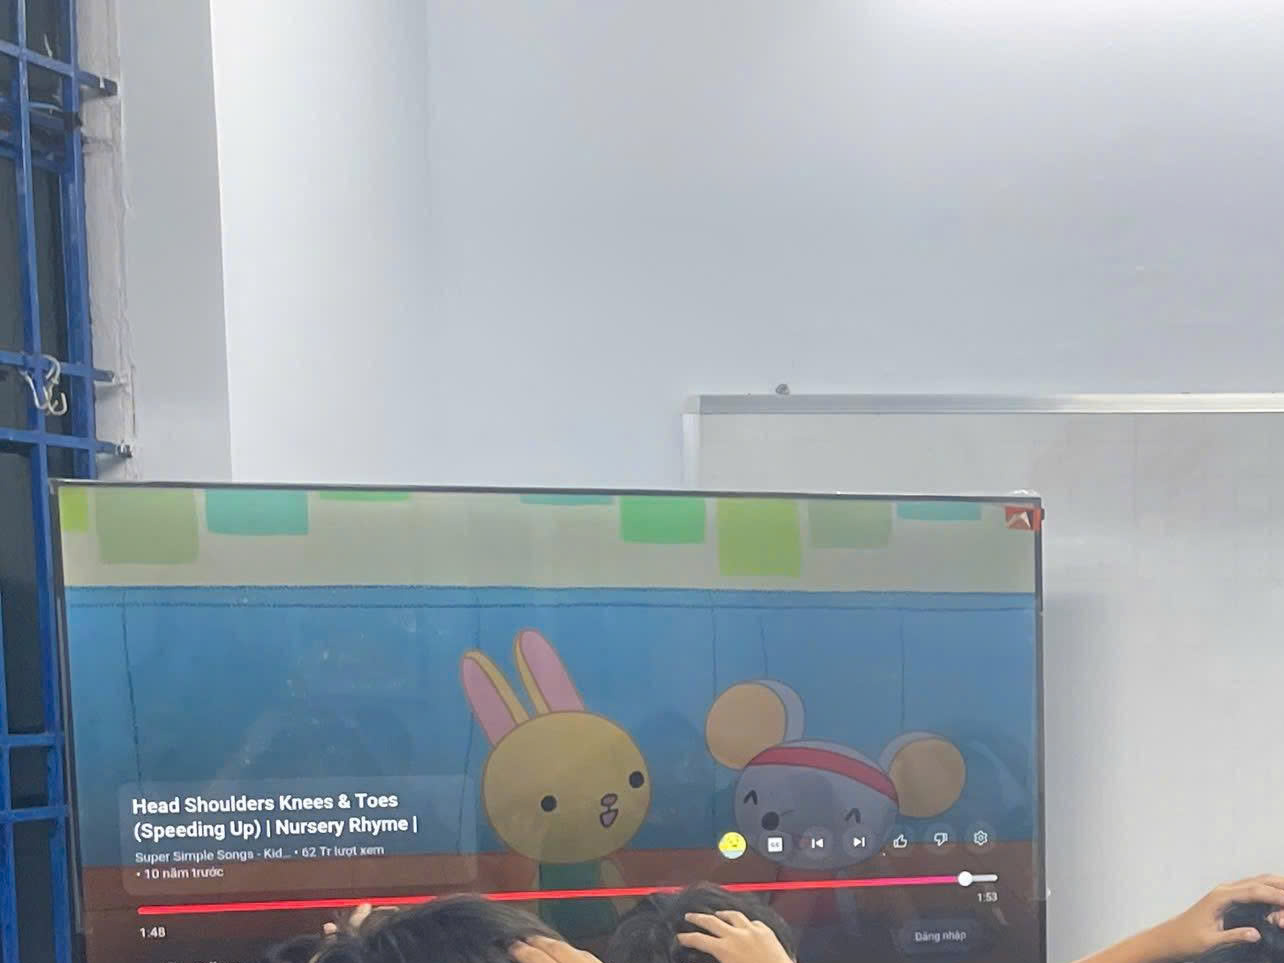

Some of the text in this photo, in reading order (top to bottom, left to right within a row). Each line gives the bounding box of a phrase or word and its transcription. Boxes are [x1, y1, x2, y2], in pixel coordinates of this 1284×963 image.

[132, 792, 399, 815] Head Shoulders Knees & Toes
[134, 821, 226, 843] (Speeding
[229, 819, 261, 840] Up)
[275, 819, 345, 838] Nursery
[349, 815, 409, 836] Rhyme
[135, 851, 170, 865] Super
[173, 849, 215, 863] Simple
[217, 849, 254, 862] Songs
[301, 846, 317, 858] 62
[319, 846, 332, 857] Tr
[360, 845, 385, 856] xem
[144, 868, 160, 880] 10
[977, 892, 998, 902] 1:53
[139, 926, 166, 938] 1:48
